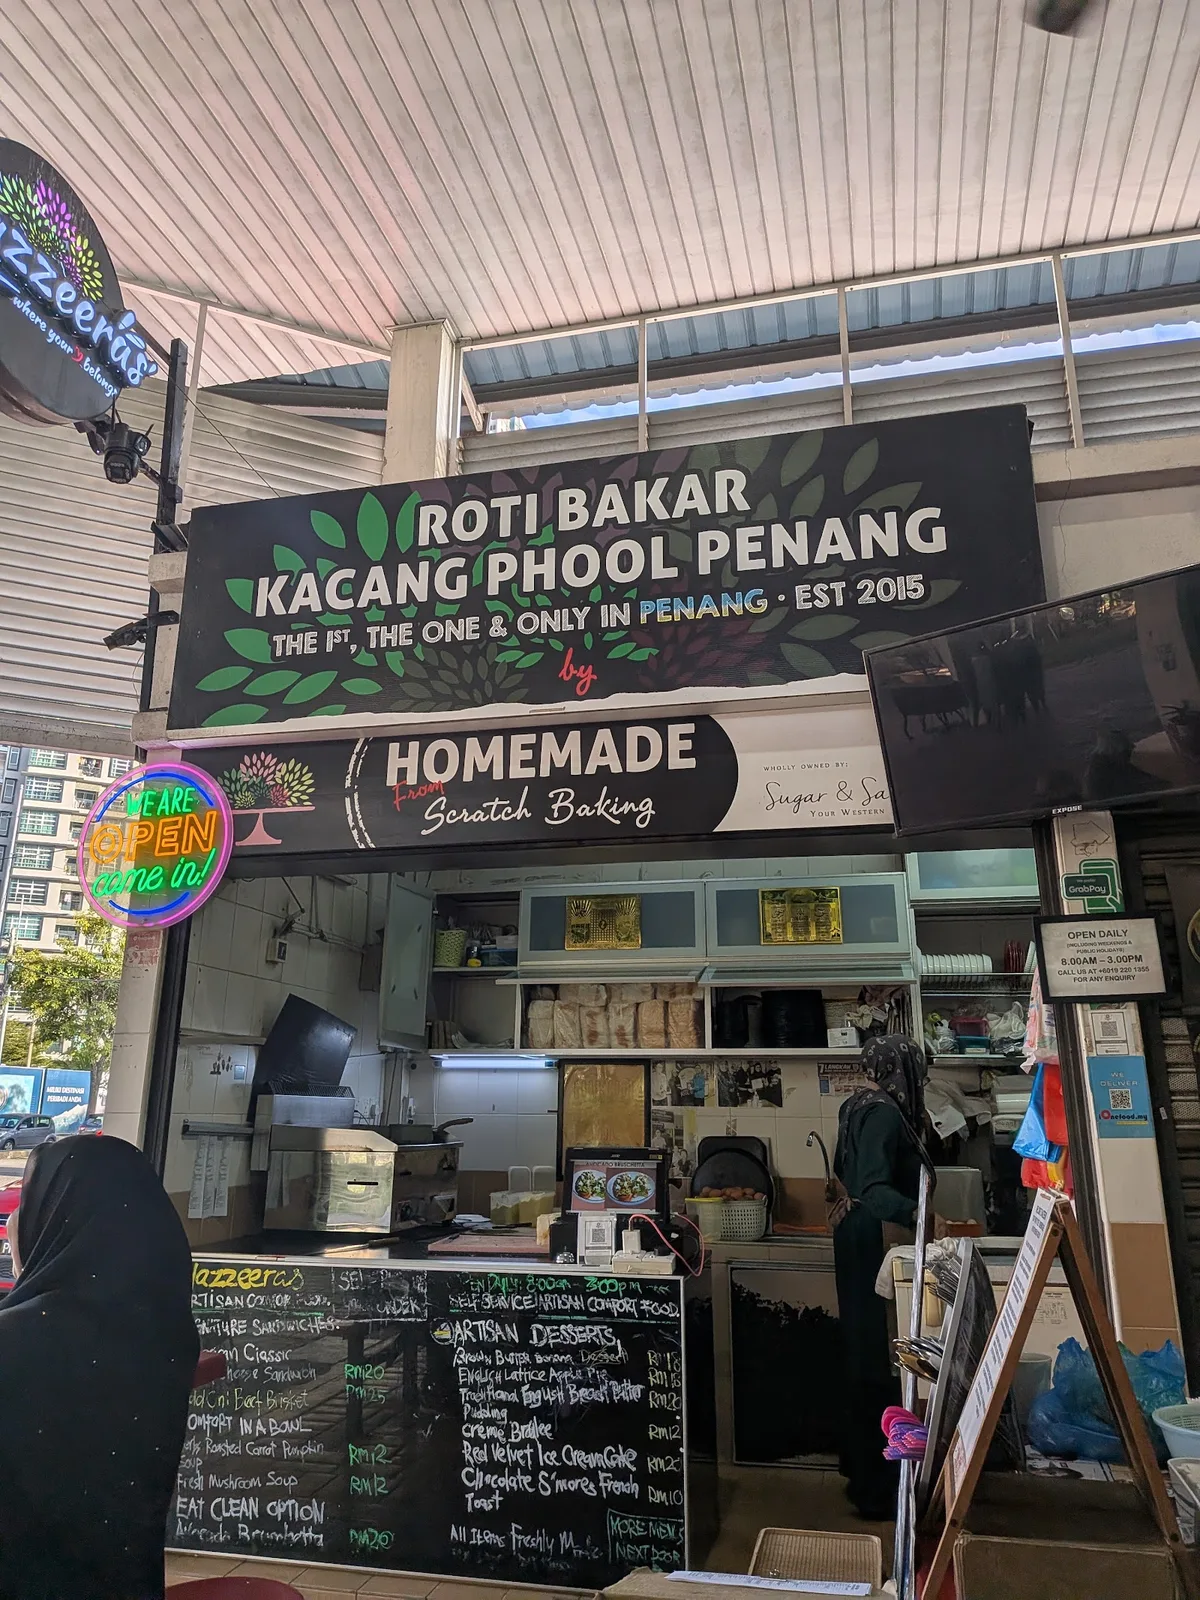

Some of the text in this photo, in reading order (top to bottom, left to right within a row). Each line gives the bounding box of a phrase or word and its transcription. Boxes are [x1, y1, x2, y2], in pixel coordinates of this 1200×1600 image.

[13, 296, 47, 332] where
[46, 328, 74, 355] your
[418, 469, 751, 547] ROTI BAKAR
[255, 507, 948, 618] KACANG PHOOL PENANG
[273, 632, 318, 657] THE
[367, 624, 413, 650] THE
[422, 617, 480, 644] ONE
[489, 615, 507, 638] &
[517, 606, 591, 634] ONLY
[601, 602, 631, 628] IN
[640, 588, 768, 624] PENANG
[795, 581, 846, 610] EST
[857, 573, 926, 606] 2015
[558, 647, 597, 696] by
[386, 722, 697, 787] HOMEMADE
[763, 764, 796, 772] WHOLLY
[800, 762, 830, 770] OWNED
[127, 787, 196, 816] WE ARE
[392, 780, 445, 813] From
[765, 776, 890, 814] Sugar & Sa
[1052, 804, 1083, 814] EXPOSE
[420, 785, 656, 836] Scratch Baking
[90, 811, 217, 865] OPEN
[92, 848, 217, 897] come in!
[1068, 885, 1106, 894] GrabPay
[1067, 929, 1129, 940] OPEN DAILY
[1061, 957, 1097, 966] 8.00AM
[1107, 955, 1143, 964] 3.00PM
[1104, 974, 1136, 982] ENQUIRY
[452, 1319, 520, 1347] ARTISAN
[222, 1364, 259, 1381] heese
[187, 1413, 313, 1437] OMFORT IN A BOWL
[462, 1440, 488, 1467] Red
[491, 1442, 534, 1469] Velvet
[538, 1444, 561, 1467] Ice
[209, 1473, 262, 1491] Mushroom
[265, 1470, 299, 1494] Soup
[461, 1467, 536, 1494] Chocolate
[598, 1470, 640, 1499] French
[176, 1494, 206, 1520] EAT
[210, 1497, 260, 1523] CLEAN
[465, 1489, 504, 1513] Toast
[450, 1523, 467, 1544] All
[510, 1522, 555, 1557] Freshly
[610, 1516, 648, 1539] MORE
[616, 1541, 649, 1561] NEXT
